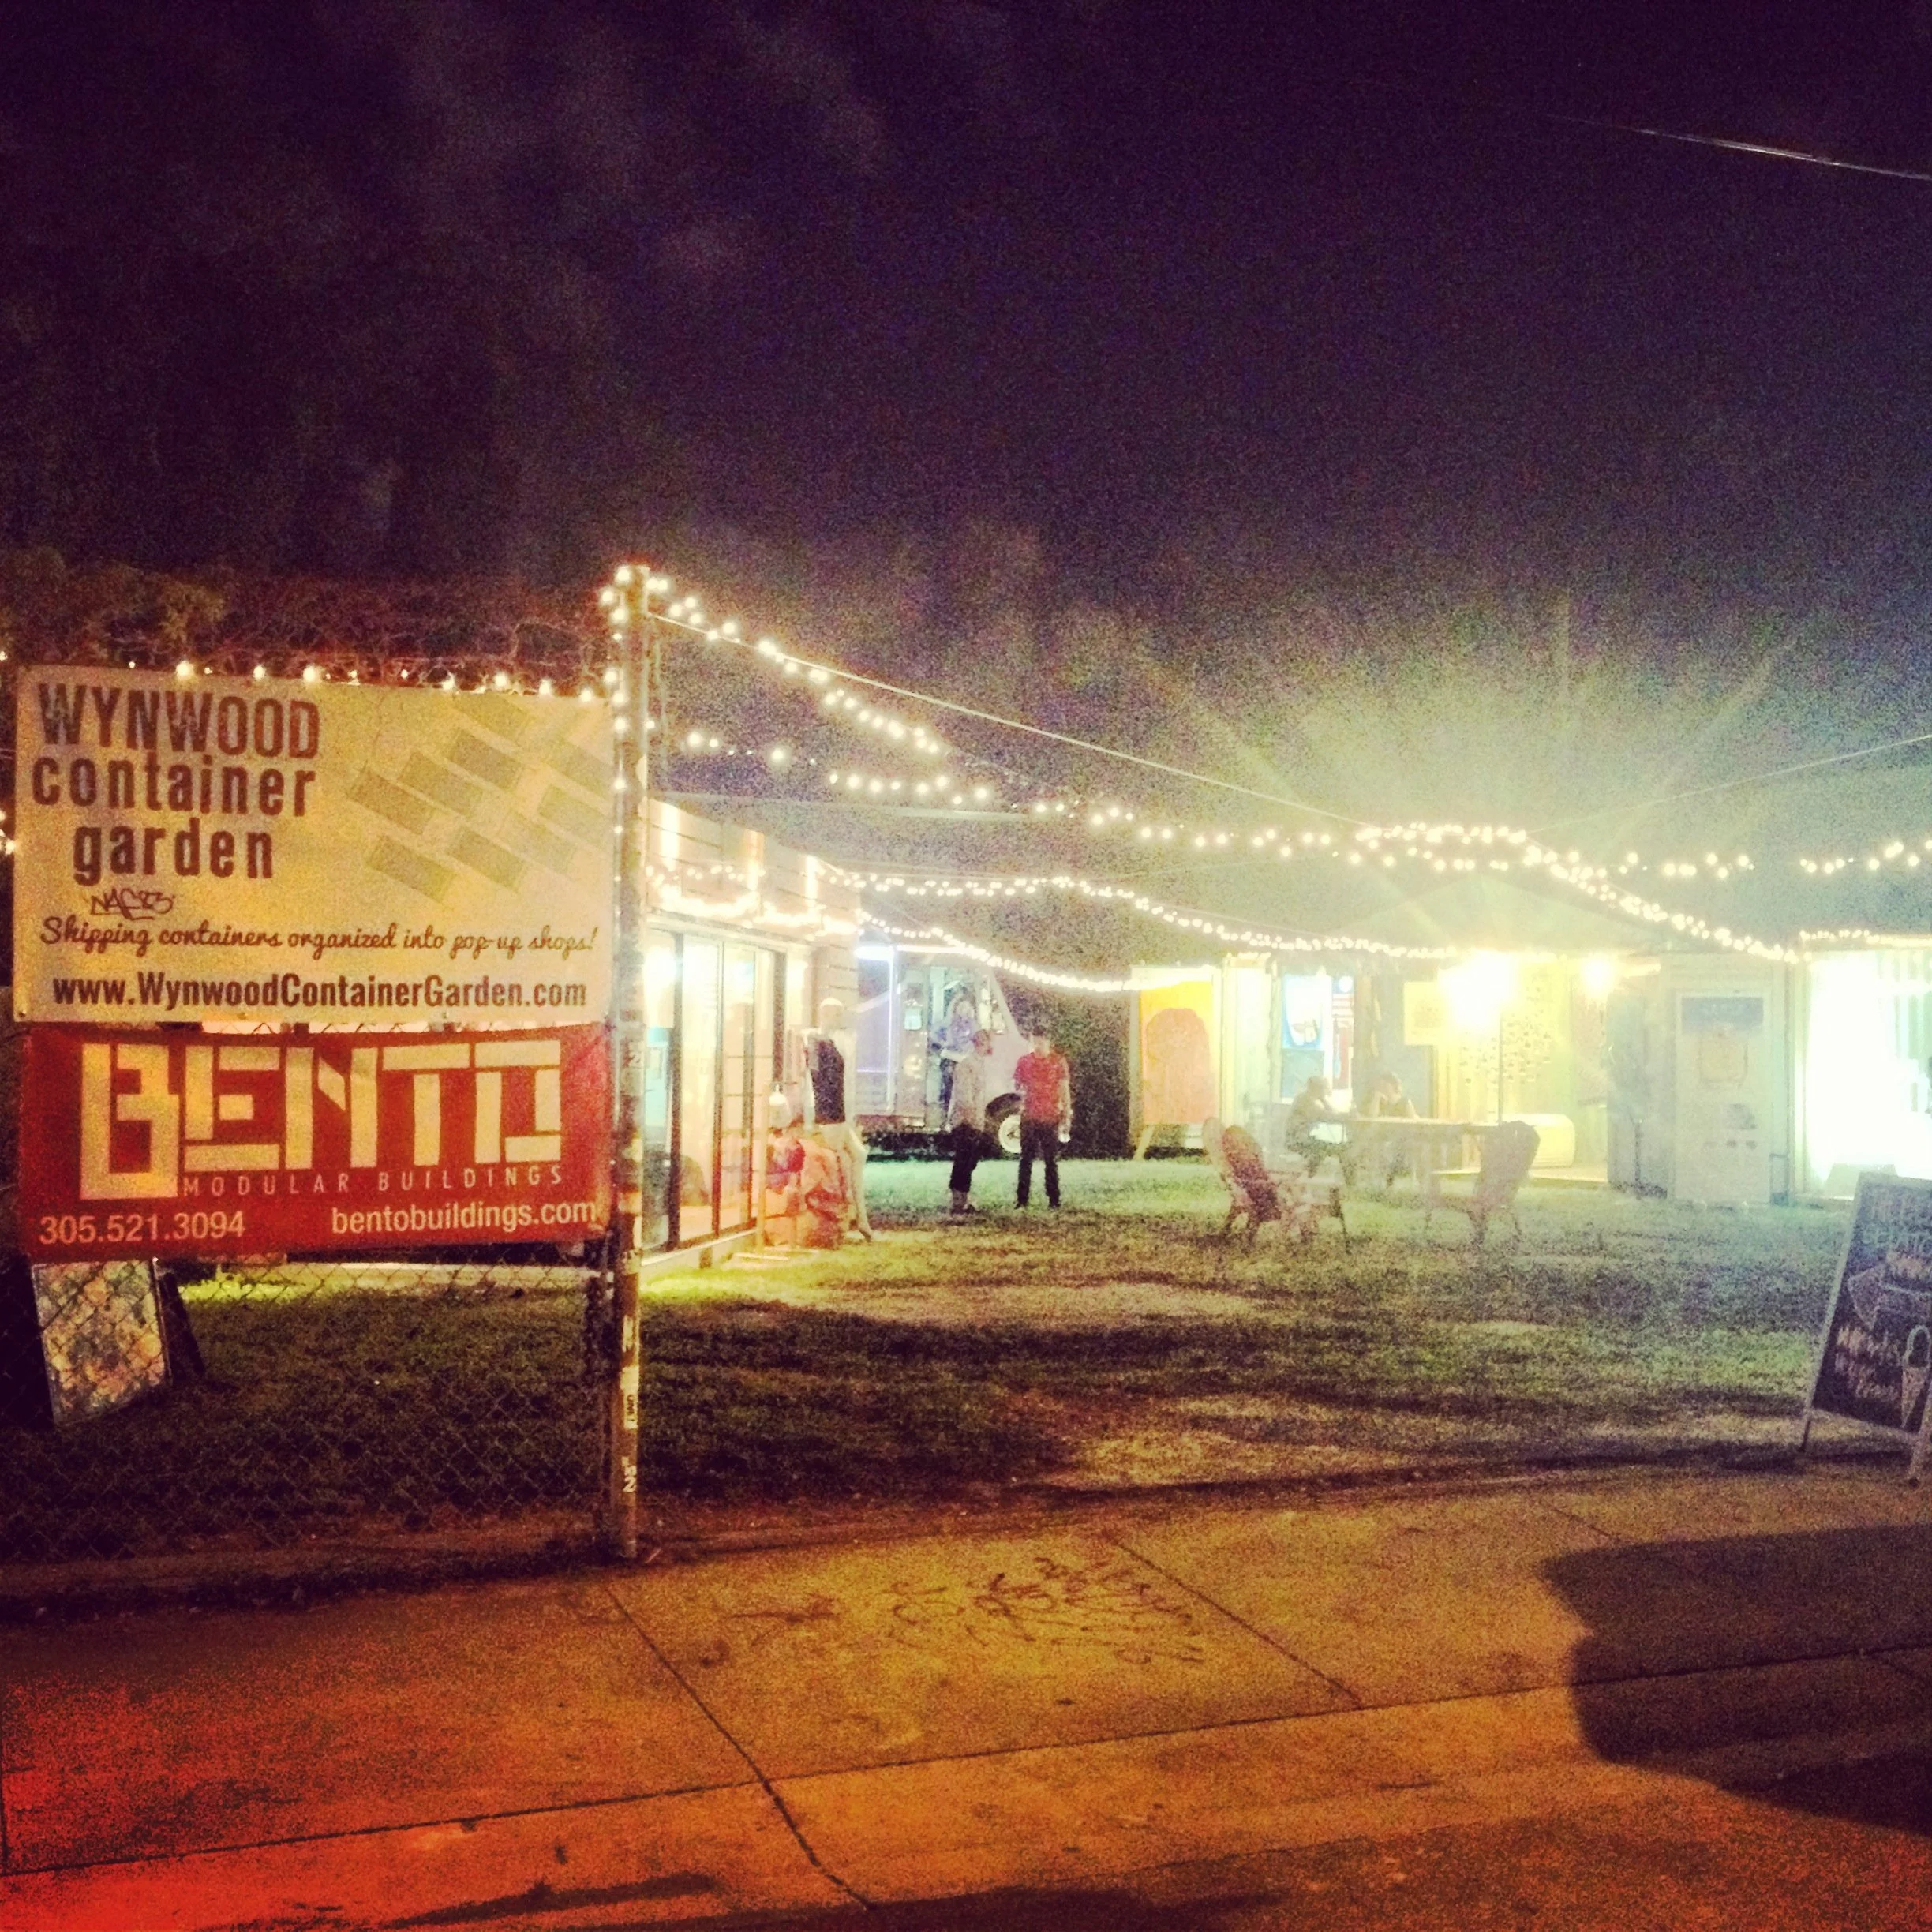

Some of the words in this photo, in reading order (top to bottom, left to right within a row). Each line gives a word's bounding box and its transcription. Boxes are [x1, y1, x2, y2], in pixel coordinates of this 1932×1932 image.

[38, 682, 320, 759] WYNWOOD
[32, 751, 317, 817] container
[73, 816, 273, 887] garden
[40, 914, 153, 957] Shipping
[159, 919, 283, 947] containers
[287, 922, 397, 960] organized
[403, 924, 446, 949] into
[449, 937, 524, 960] pop-up
[528, 923, 598, 960] shops!
[52, 971, 587, 1011] www.WynwoodContainerGarden.com
[80, 1039, 561, 1200] BENTO
[183, 1168, 348, 1196] MODULAR
[378, 1164, 563, 1193] BUILDINGS
[39, 1210, 246, 1245] 305.521.3094
[331, 1200, 597, 1234] bentobuildings.com
